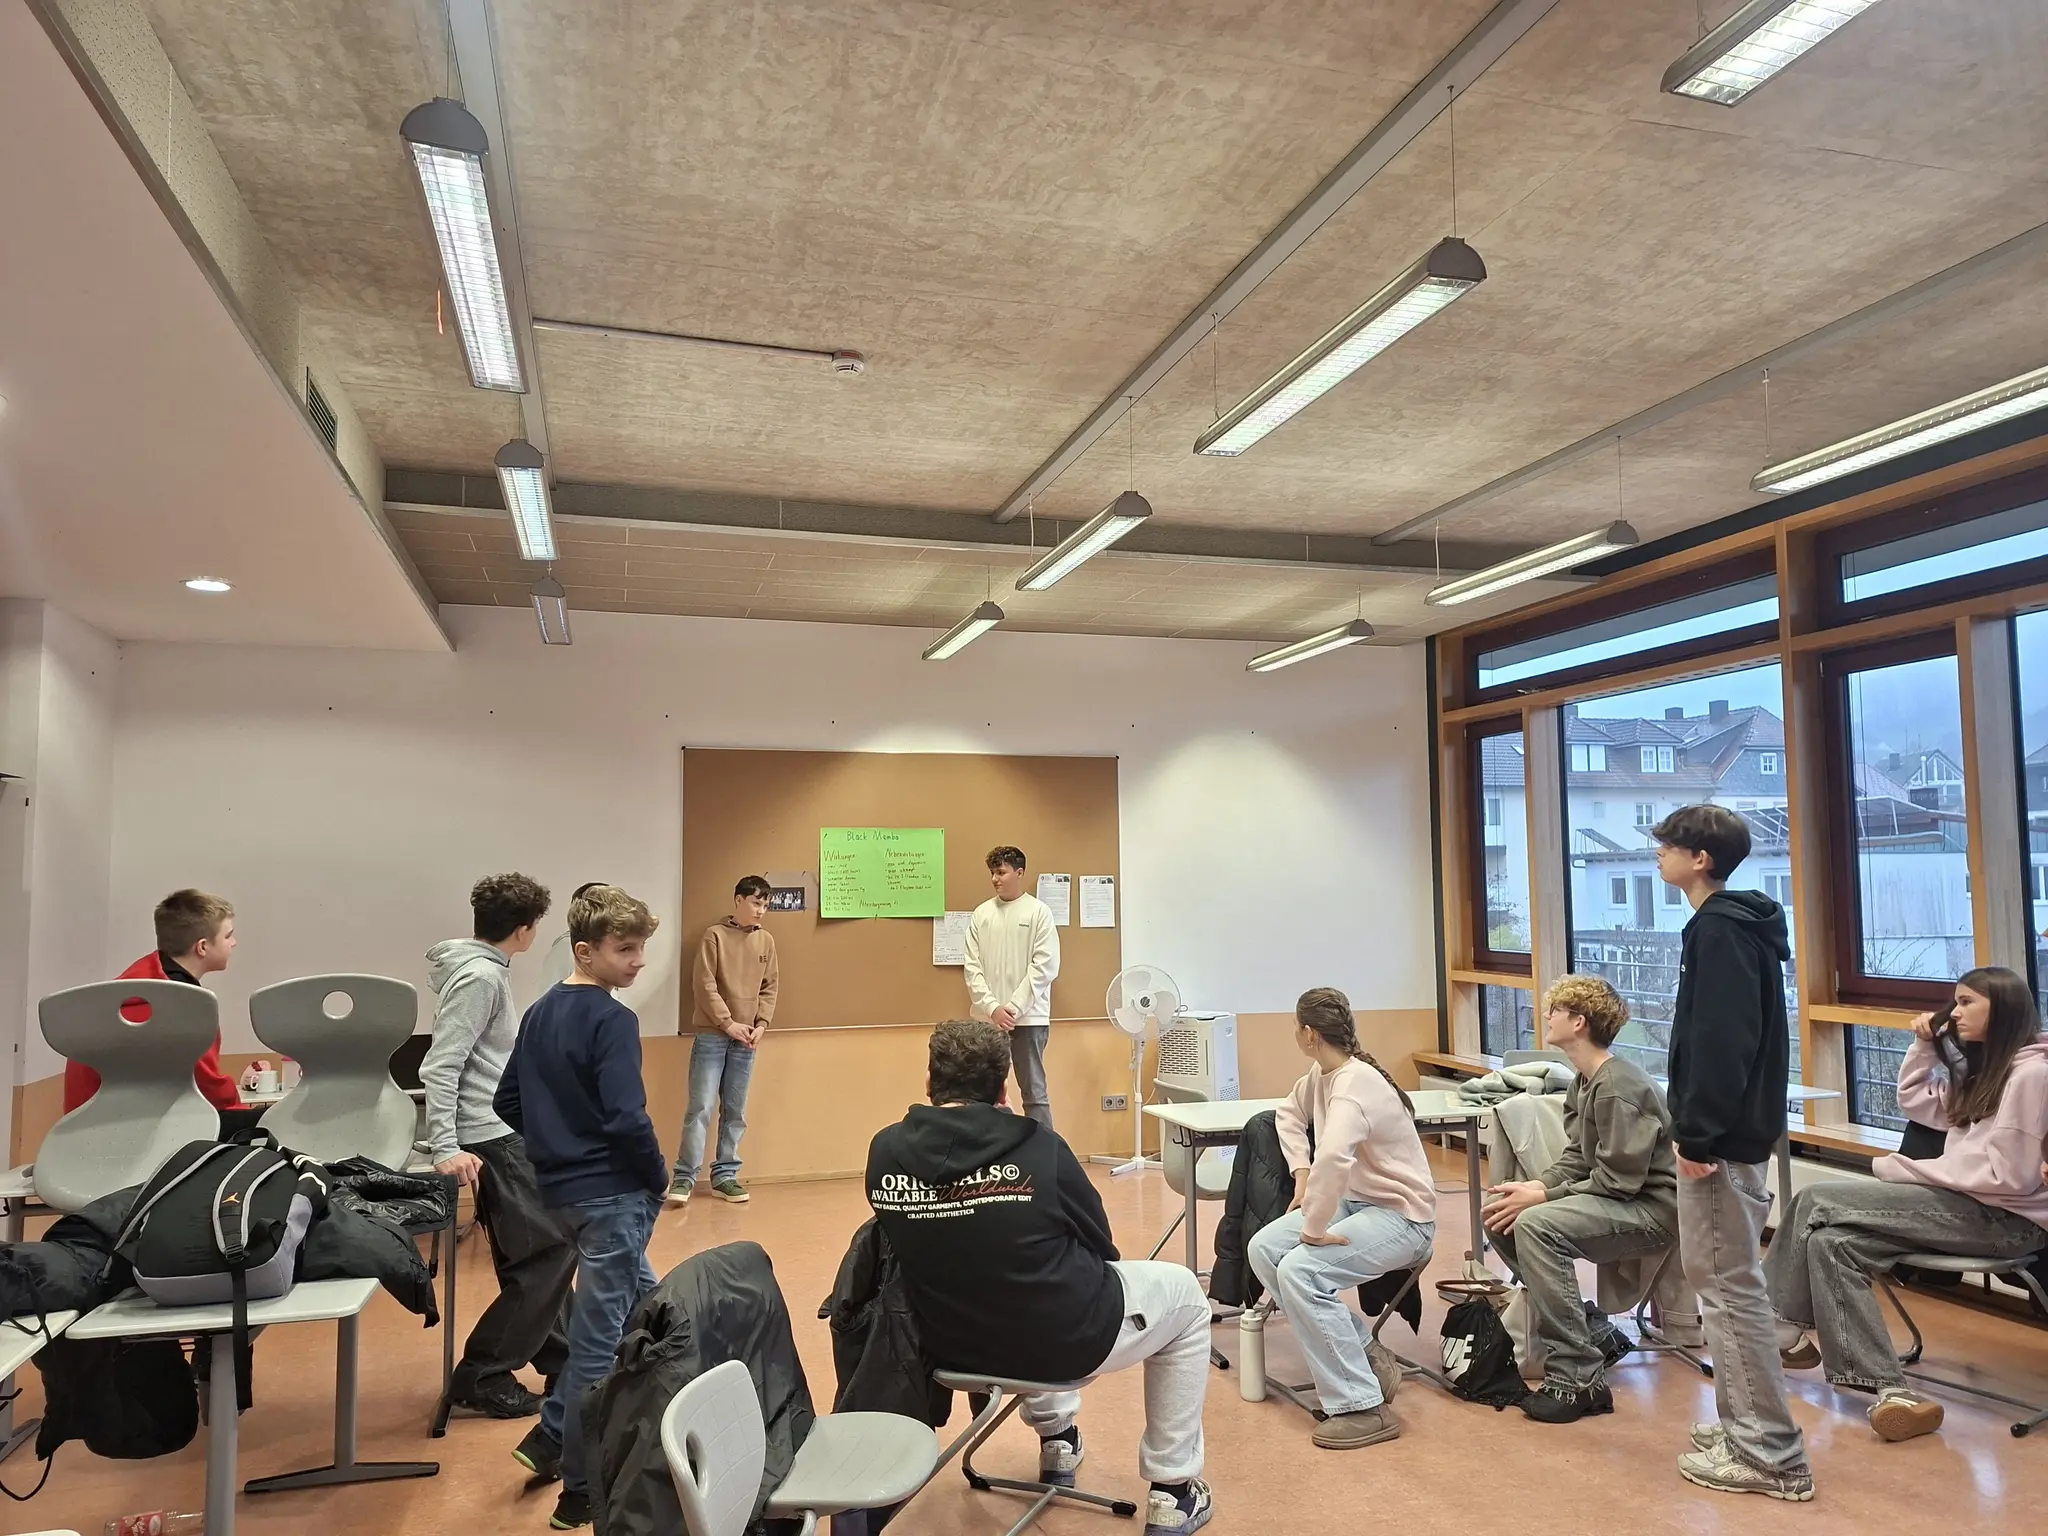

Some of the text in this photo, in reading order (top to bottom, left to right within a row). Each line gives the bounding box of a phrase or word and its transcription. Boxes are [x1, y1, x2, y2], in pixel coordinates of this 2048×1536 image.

[847, 830, 899, 841] Black Mamba
[871, 1174, 1035, 1202] AVAILABLE Worldwide
[902, 1204, 928, 1212] QUALITY
[927, 1200, 962, 1210] GARMENTS,
[963, 1195, 1017, 1207] CONTEMPORARY
[1017, 1195, 1033, 1203] EDIT
[935, 1208, 975, 1218] AESTHETICS
